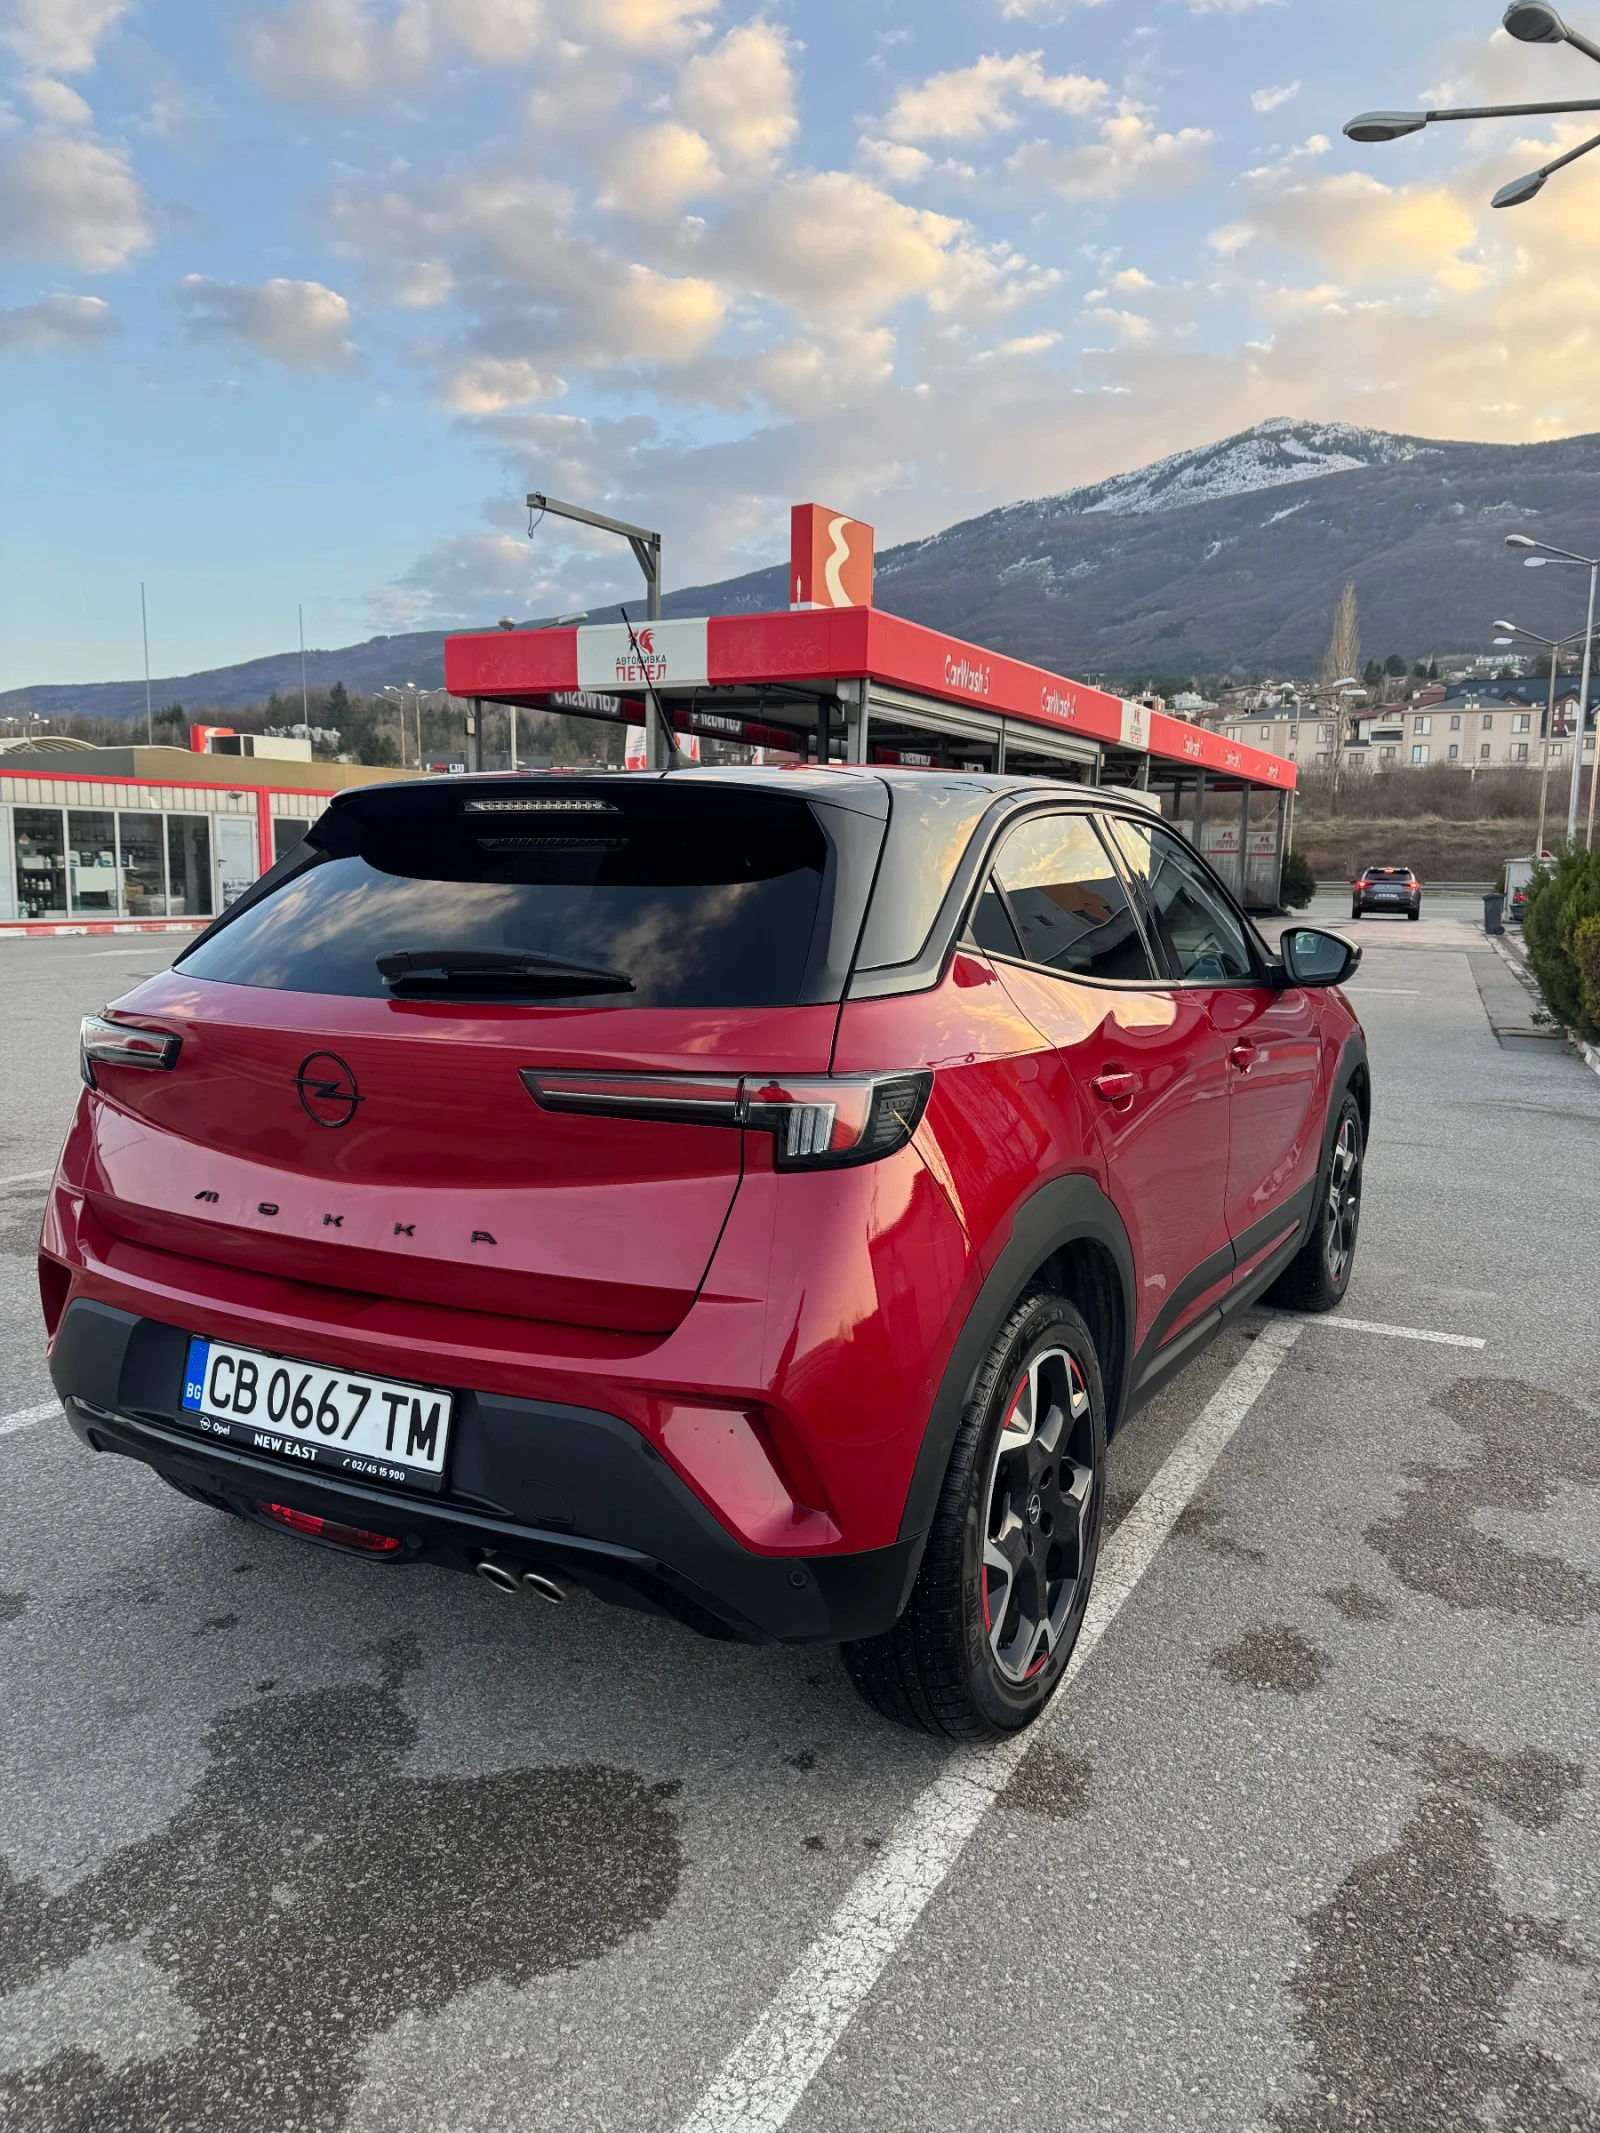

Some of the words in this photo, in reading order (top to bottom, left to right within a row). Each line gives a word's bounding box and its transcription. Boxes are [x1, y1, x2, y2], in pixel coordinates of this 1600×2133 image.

[615, 664, 667, 681] ПЕТЕЛ
[945, 654, 983, 694] CarWash
[984, 667, 990, 695] 5
[1041, 686, 1070, 718] CarWash
[194, 1190, 498, 1245] MOKKA
[186, 1382, 202, 1400] BG
[209, 1354, 260, 1415] CB
[267, 1368, 372, 1440] 0667
[381, 1391, 442, 1461] TM
[212, 1424, 231, 1436] Opel
[253, 1433, 284, 1452] NEW
[284, 1441, 319, 1461] EAST
[351, 1460, 378, 1476] 02/45
[378, 1466, 388, 1477] 15
[388, 1468, 406, 1481] 900
